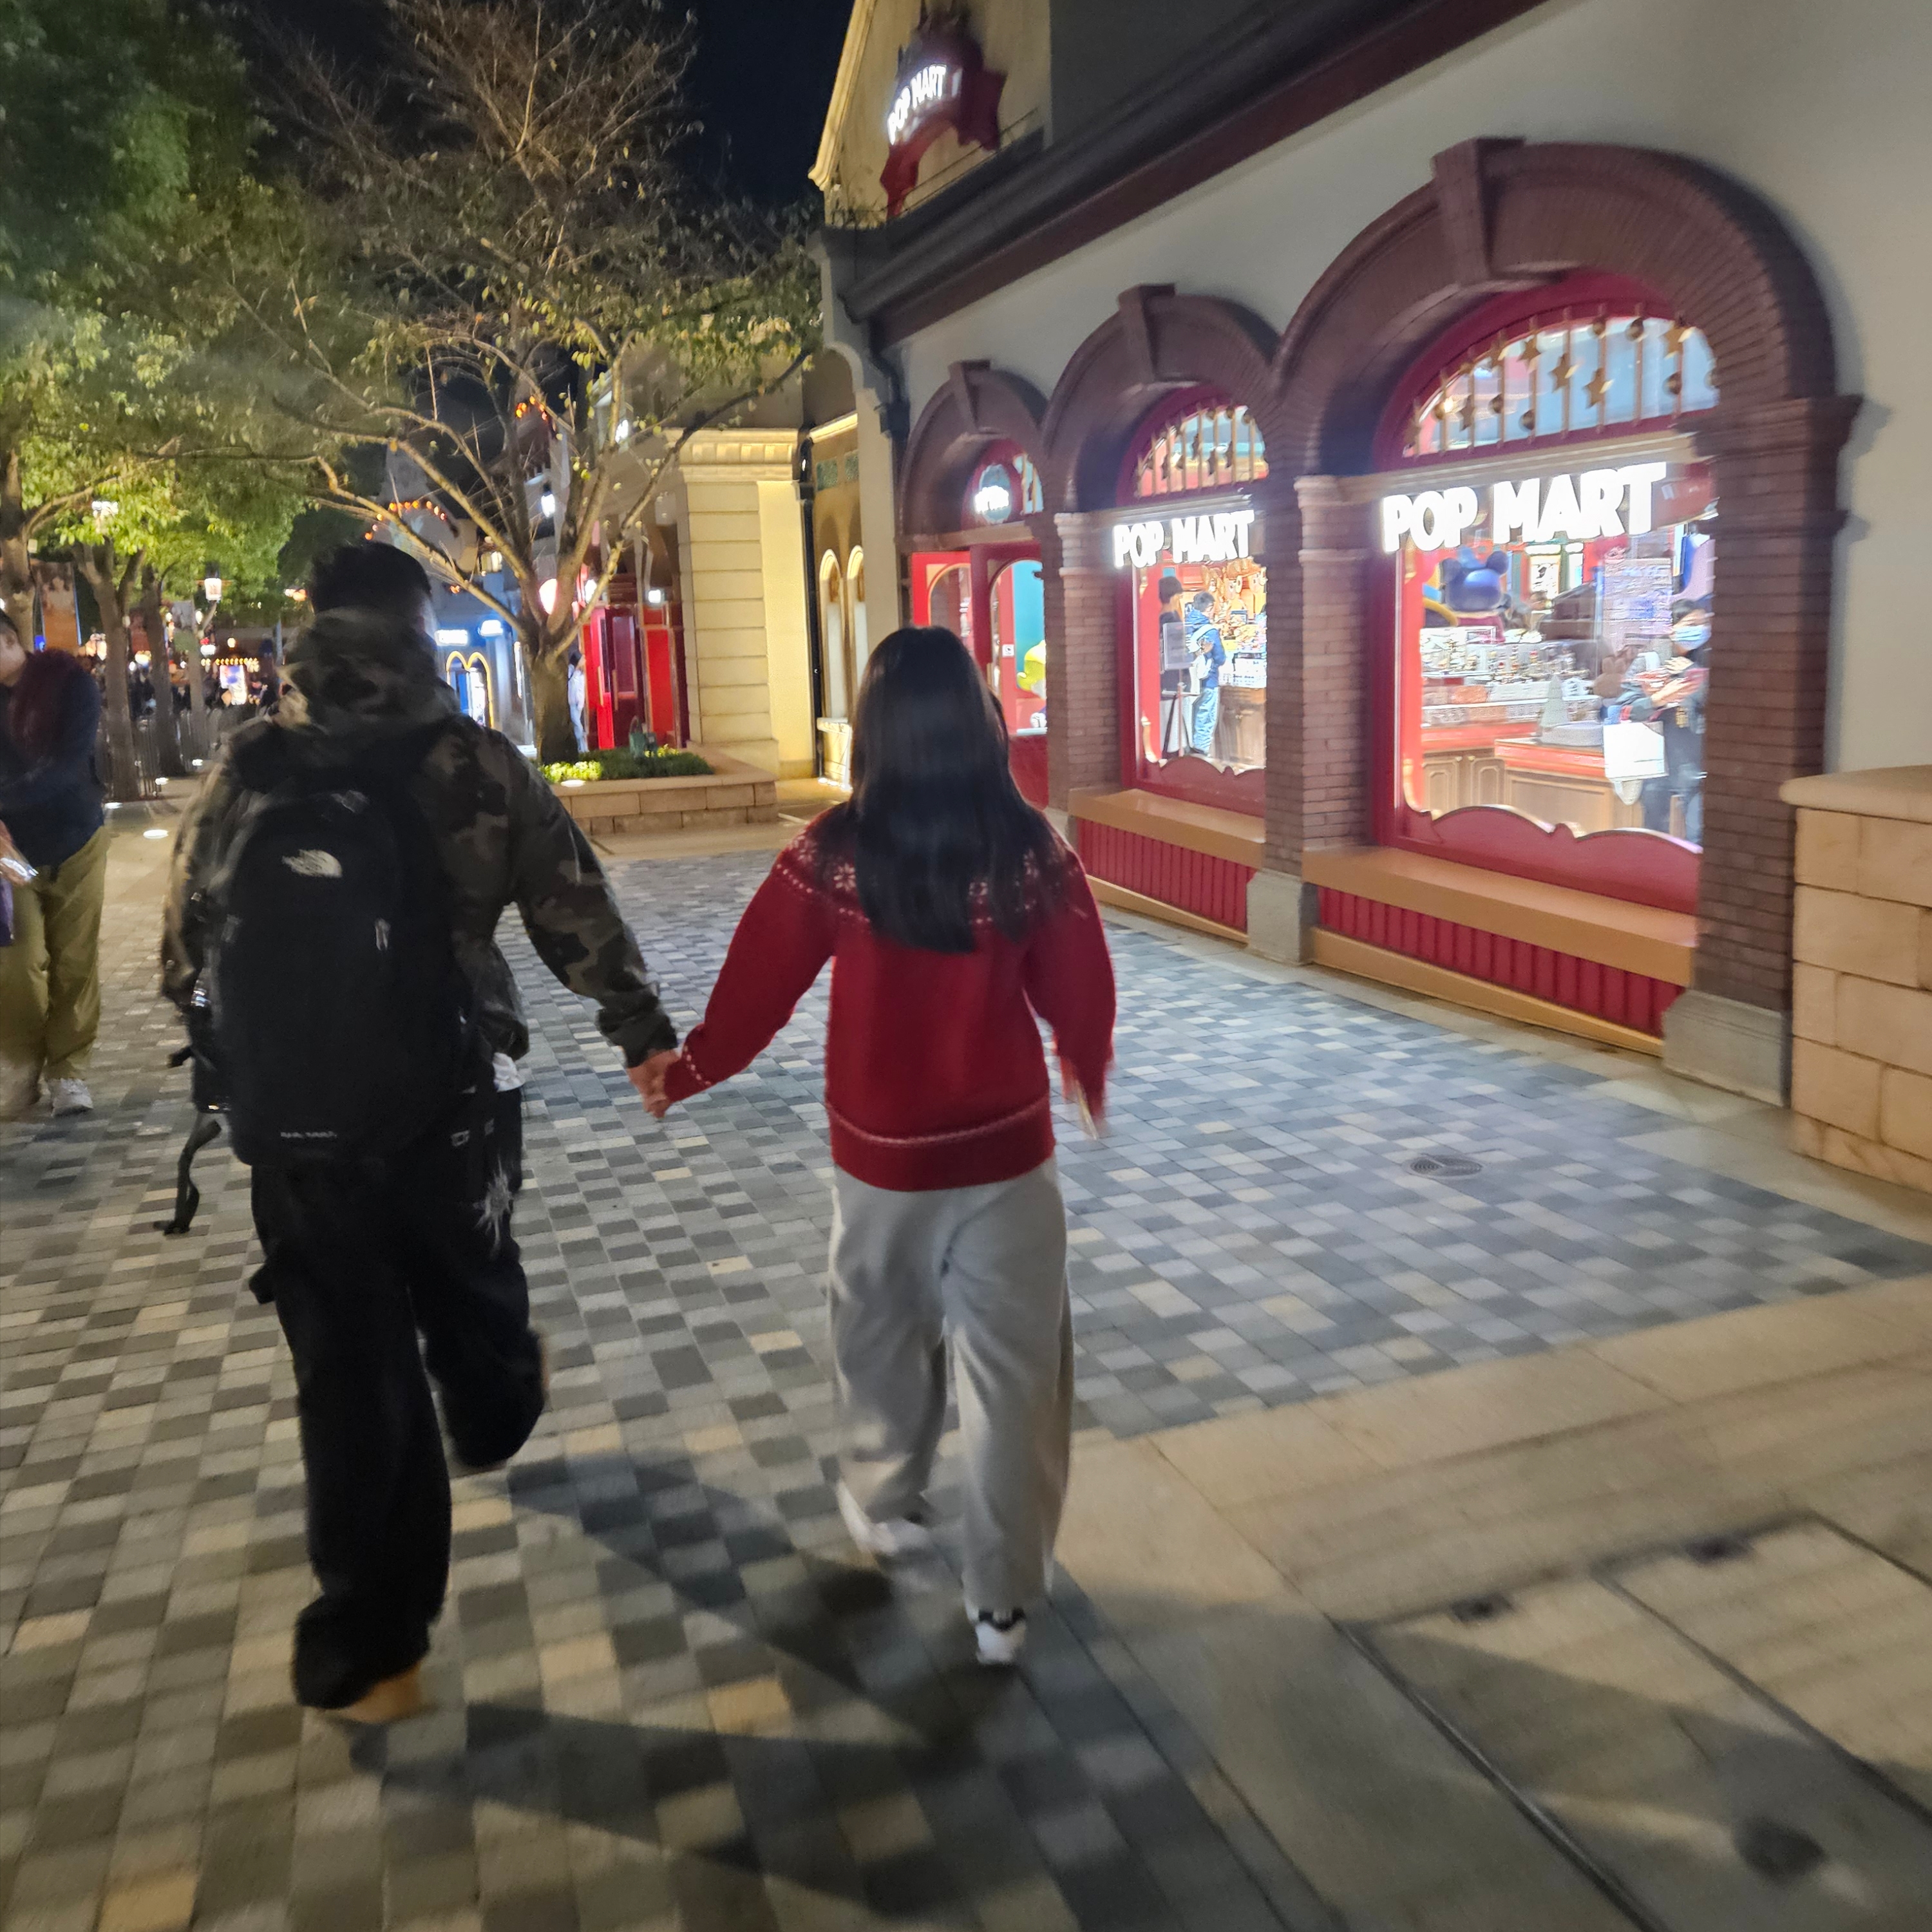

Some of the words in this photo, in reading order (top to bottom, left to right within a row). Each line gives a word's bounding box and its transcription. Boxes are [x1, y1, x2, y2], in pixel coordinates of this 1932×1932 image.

[887, 86, 911, 146] POP
[911, 64, 947, 109] MART
[1113, 520, 1164, 569] POP
[1171, 509, 1255, 564] MART
[1383, 486, 1478, 553] POP
[1493, 462, 1667, 544] MART
